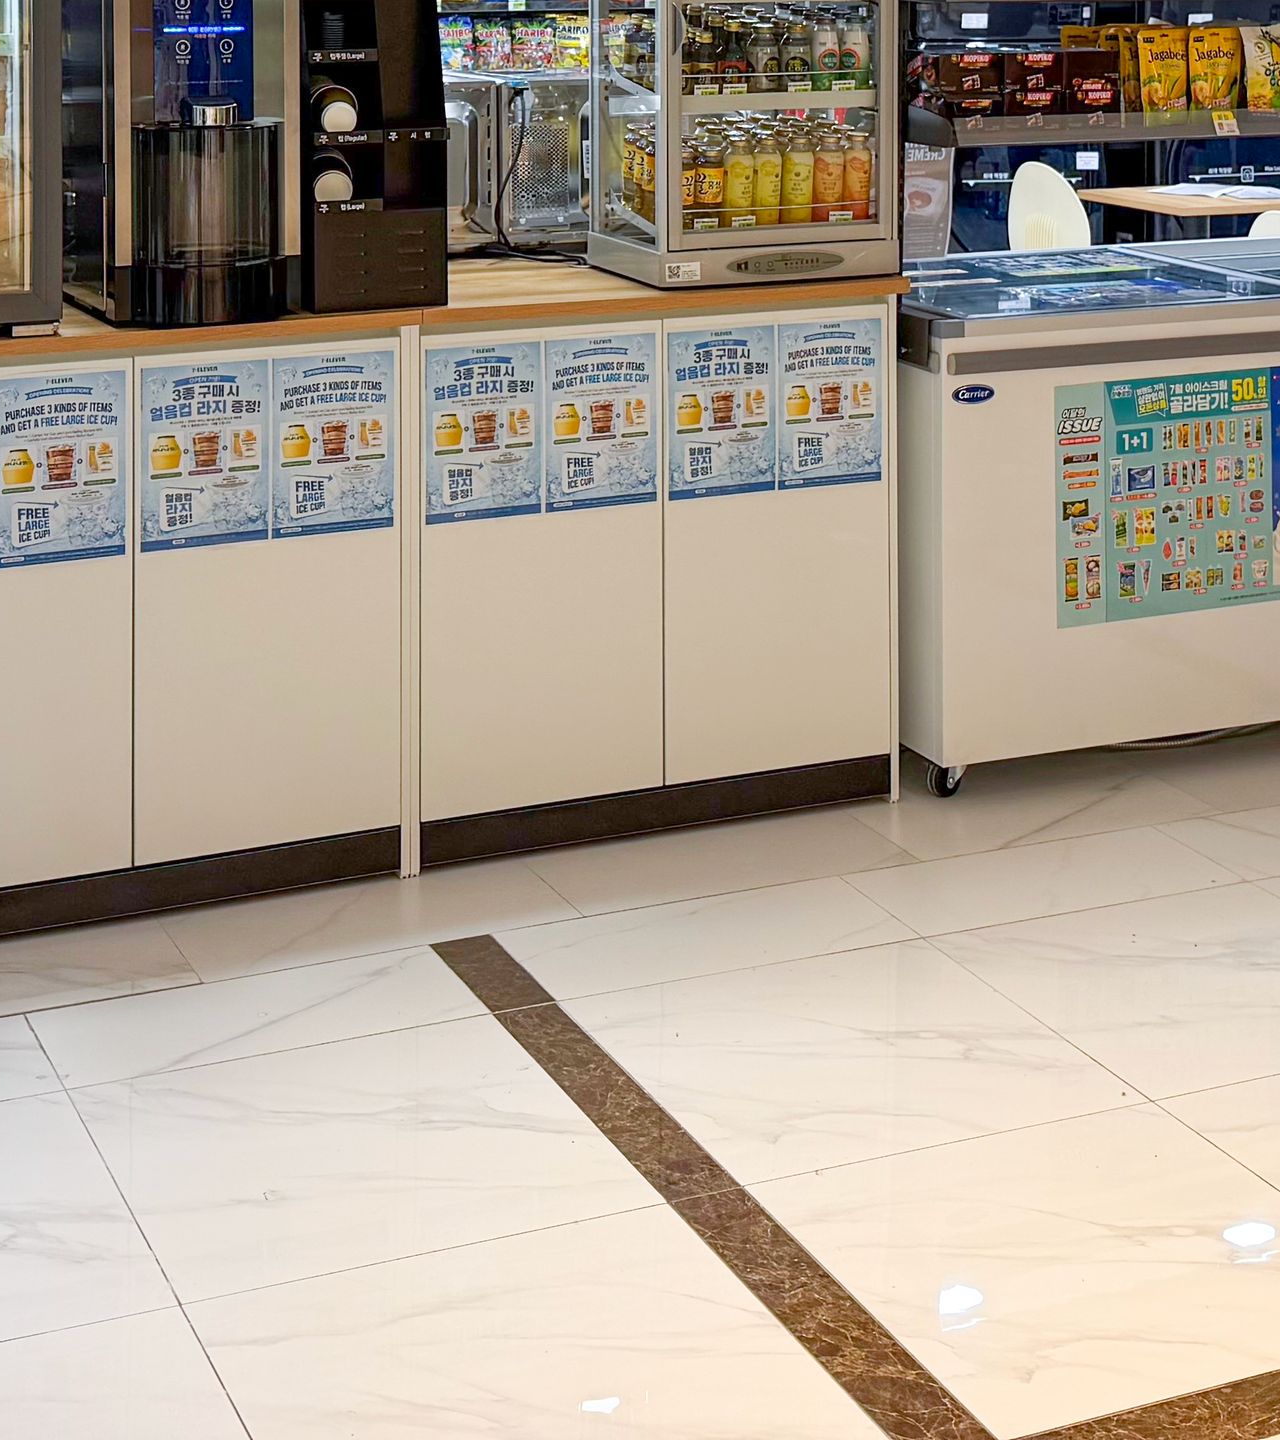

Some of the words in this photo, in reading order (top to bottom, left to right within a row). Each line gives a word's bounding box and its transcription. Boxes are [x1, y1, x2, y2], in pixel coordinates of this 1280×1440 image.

[516, 28, 553, 38] HARIBO
[1028, 54, 1055, 62] KOPIKO
[1027, 92, 1054, 101] KOPIKO
[1088, 91, 1113, 99] KOPIKO
[454, 369, 475, 381] 3종
[477, 366, 501, 379] 구매
[504, 365, 515, 377] 시
[434, 384, 472, 400] 얼음컵
[476, 381, 502, 395] 라지
[507, 380, 534, 392] 증정!
[1170, 384, 1183, 394] 7월
[1185, 380, 1227, 393] 아이스크림
[958, 388, 990, 400] Carrier
[1170, 392, 1228, 413] 골라담기!
[5, 405, 45, 422] PURCHASE
[47, 404, 52, 413] 3
[54, 403, 76, 413] KINDS
[78, 403, 87, 412] OF
[89, 402, 113, 412] ITEMS
[0, 424, 15, 435] AND
[18, 421, 32, 432] GET
[34, 420, 40, 428] A
[41, 417, 59, 428] FREE
[61, 415, 84, 426] LARGE
[86, 415, 97, 425] ICE
[100, 415, 117, 425] CUP!
[1058, 417, 1102, 435] ISSUE
[798, 437, 822, 448] FREE
[1122, 431, 1148, 451] 1+1
[798, 448, 822, 458] LARGE
[799, 458, 809, 468] ICE
[18, 508, 49, 521] FREE
[18, 520, 50, 532] LARGE
[19, 532, 32, 543] ICE
